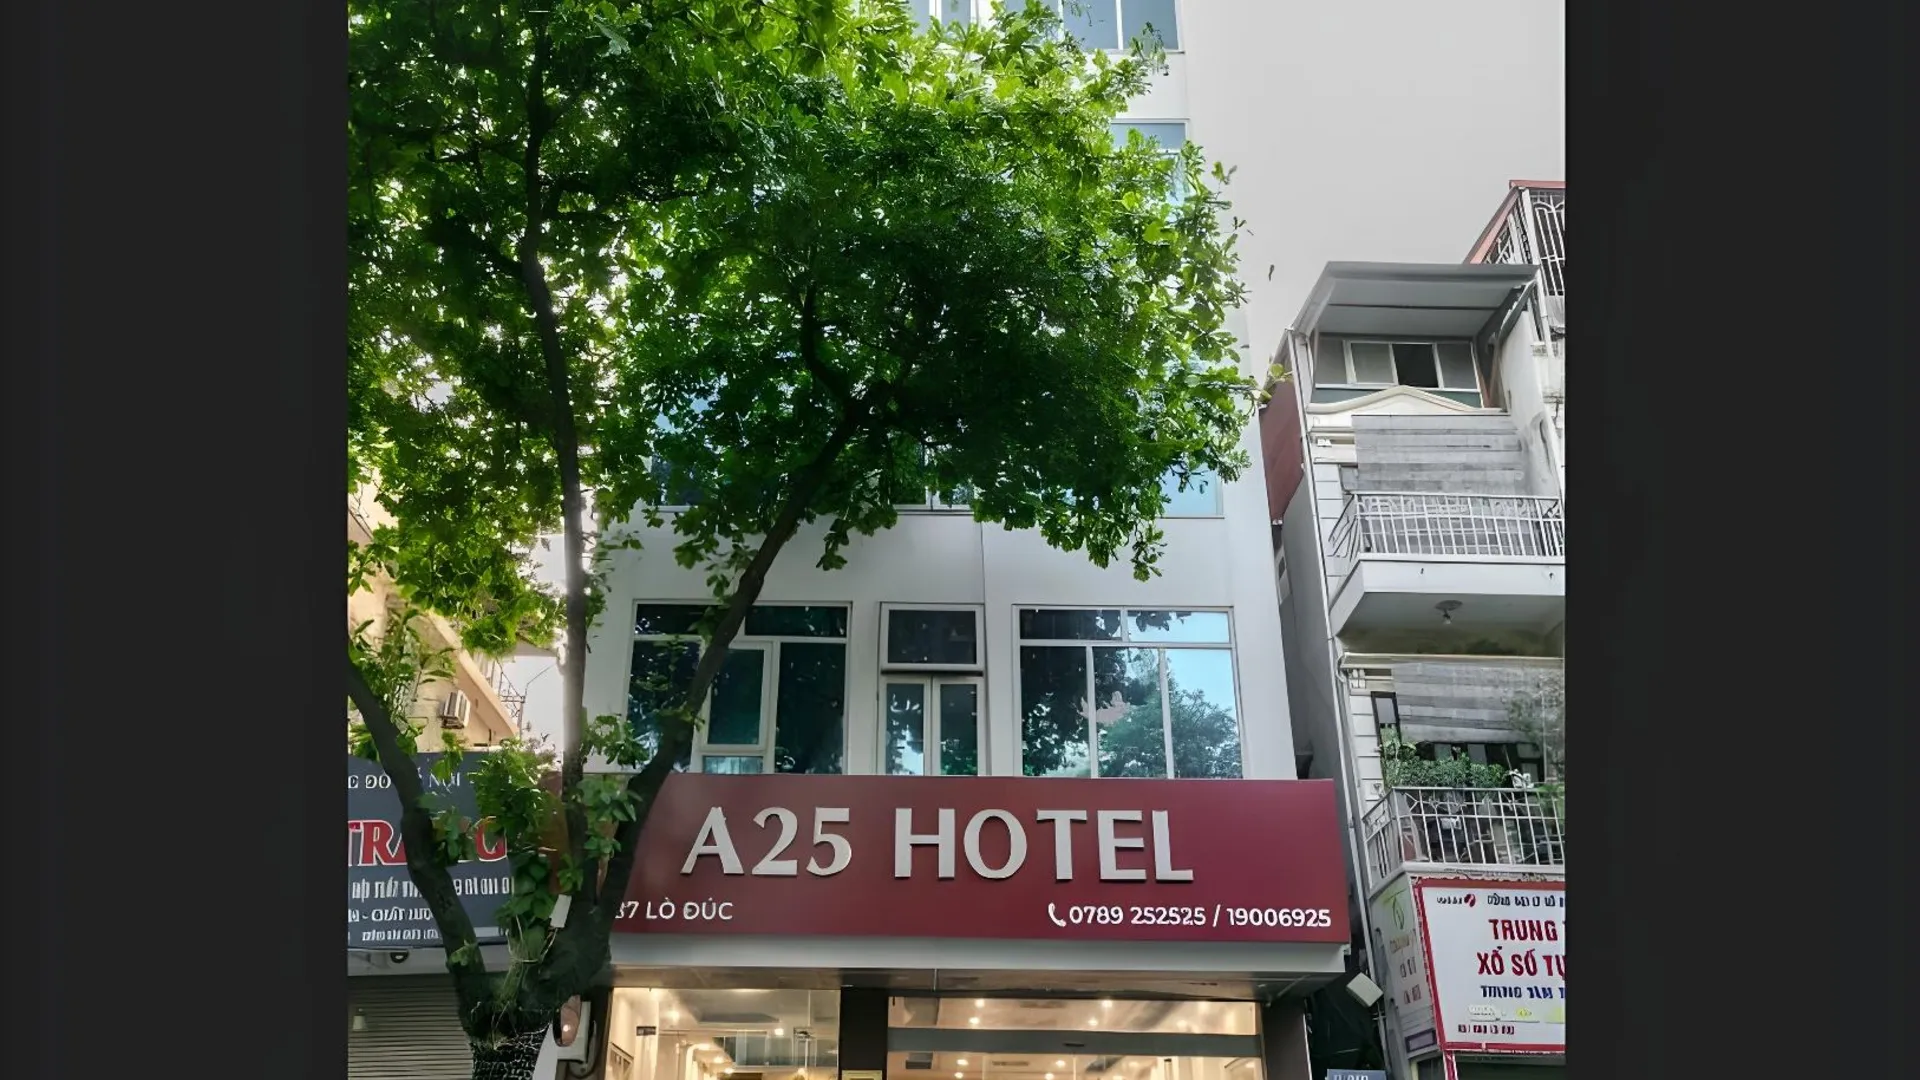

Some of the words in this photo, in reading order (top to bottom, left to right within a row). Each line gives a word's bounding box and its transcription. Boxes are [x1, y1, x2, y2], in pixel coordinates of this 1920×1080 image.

[680, 806, 852, 877] A25
[894, 807, 1194, 882] HOTEL
[646, 896, 676, 920] LÒ
[1069, 905, 1124, 925] 0789
[1130, 906, 1207, 926] 252525
[1213, 904, 1222, 928] /
[1227, 907, 1332, 928] 19006925
[1488, 918, 1559, 941] TRUNG
